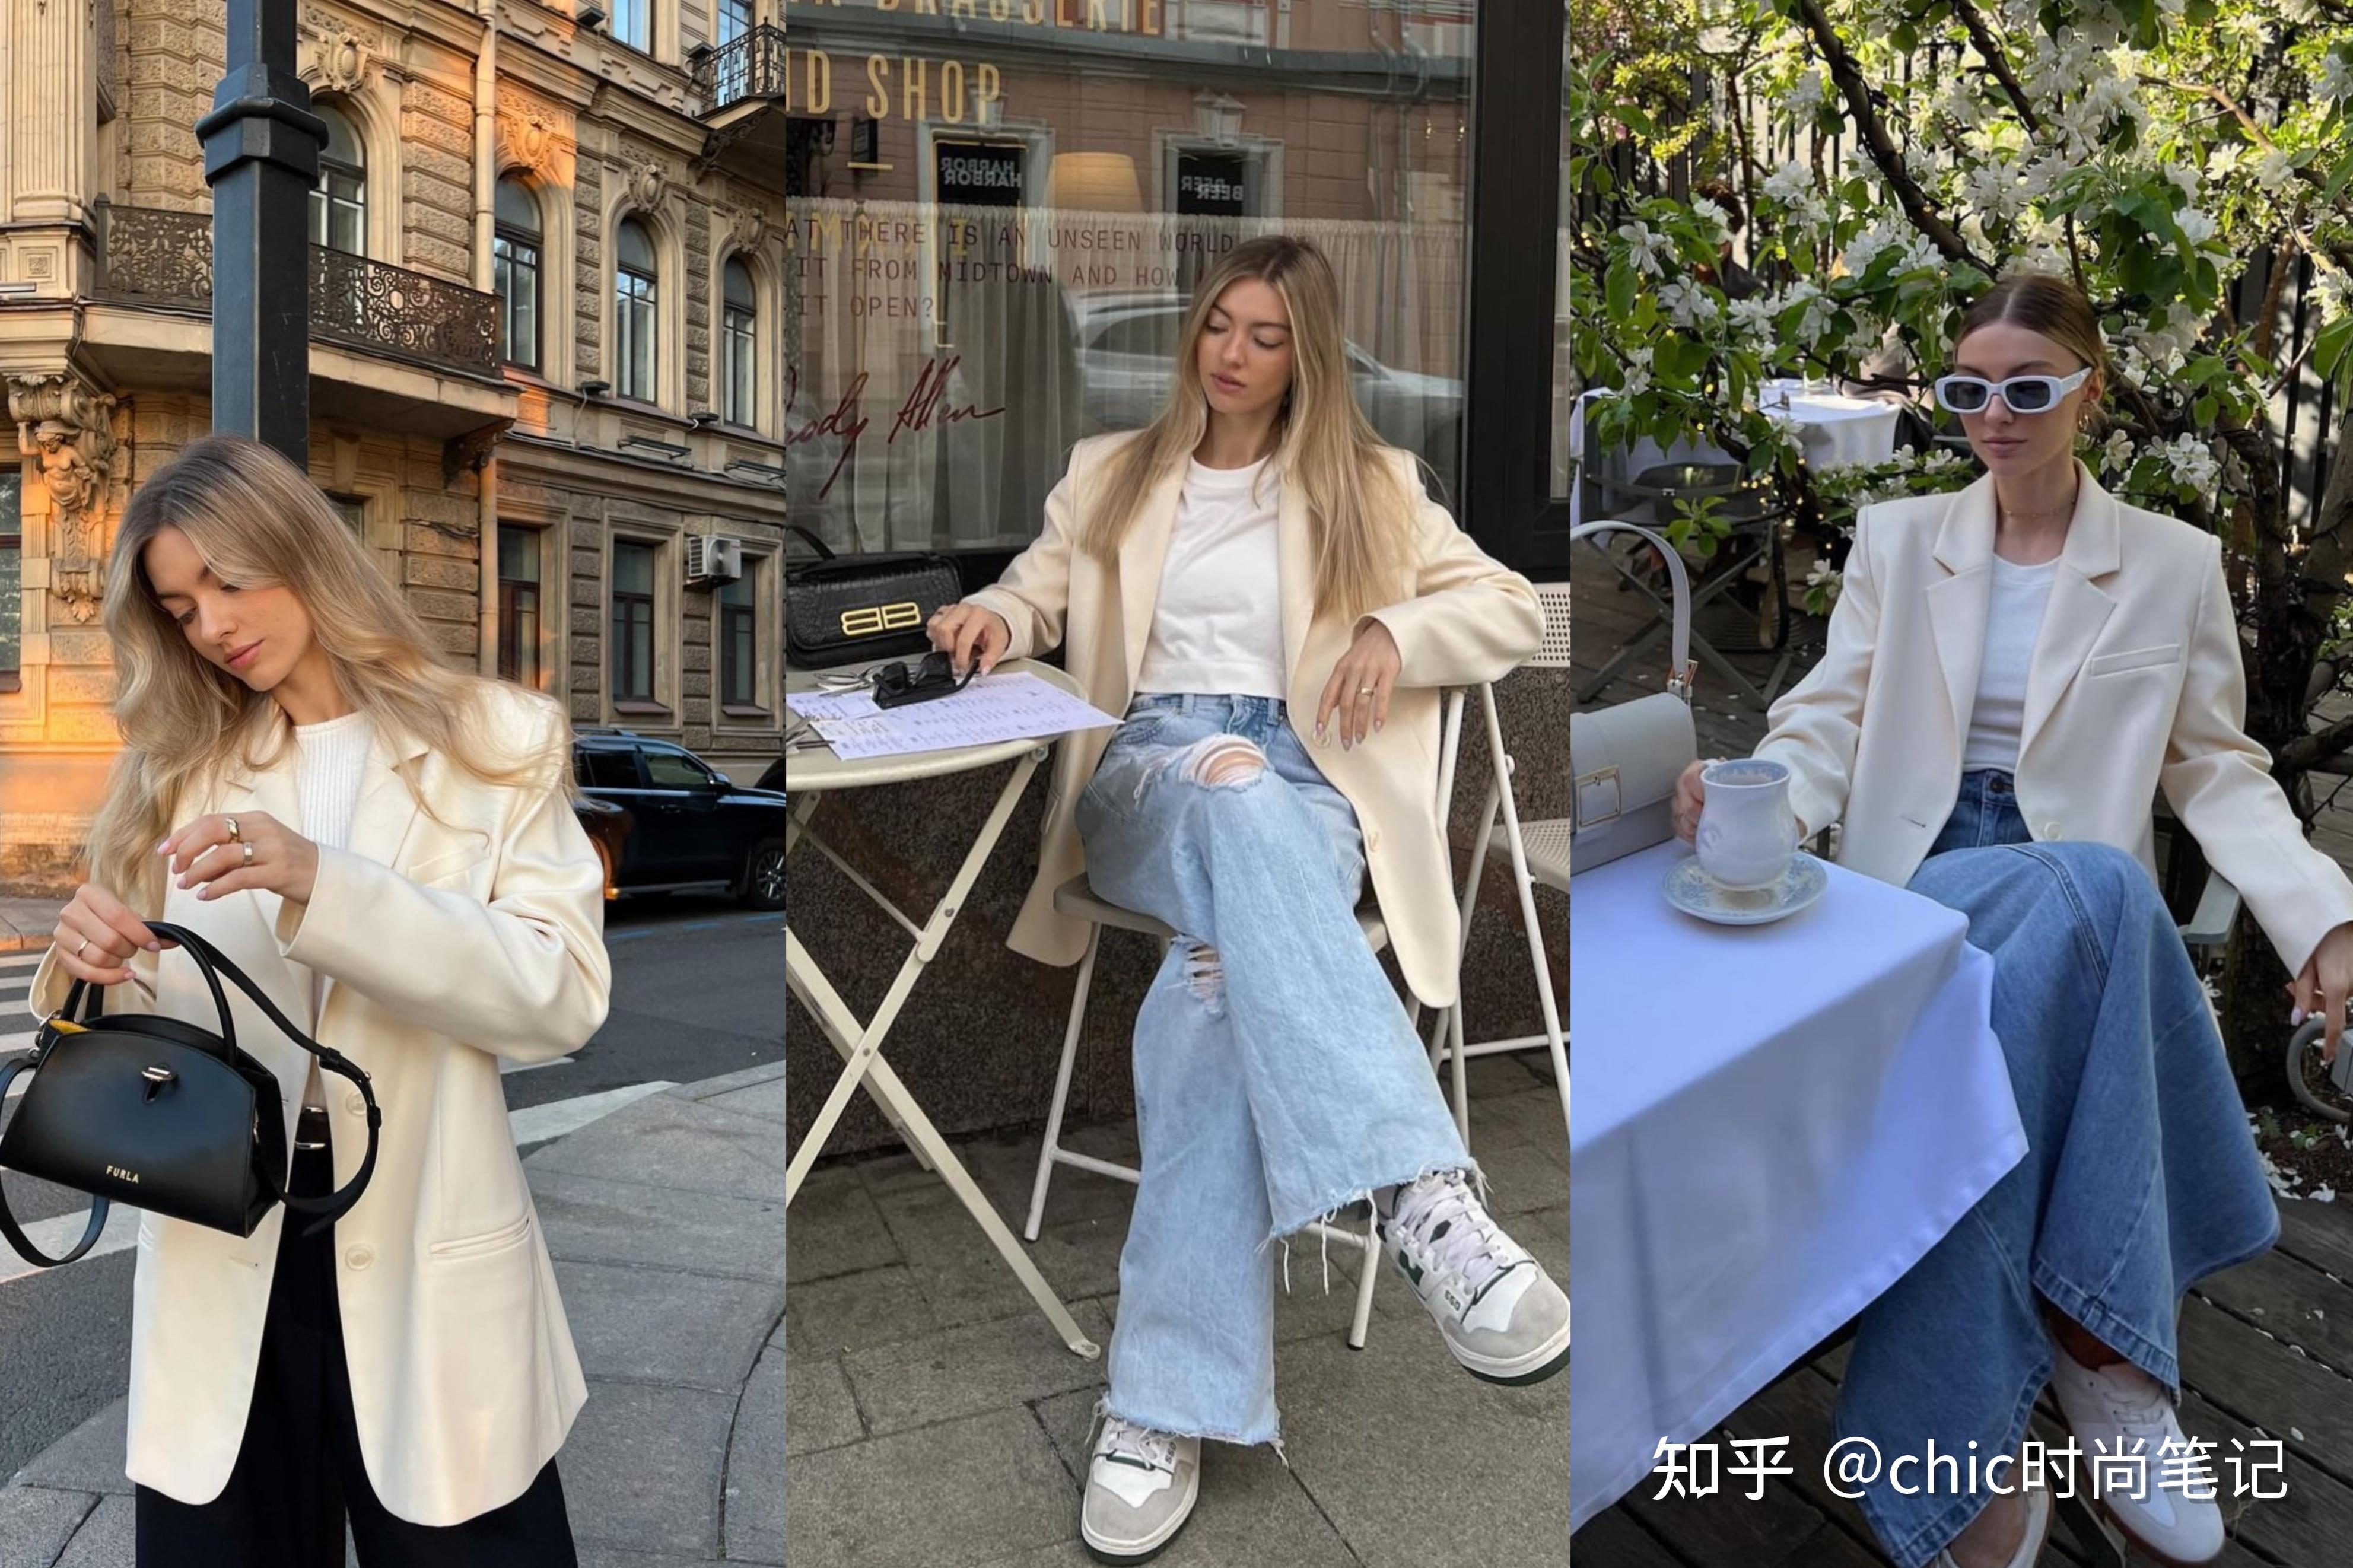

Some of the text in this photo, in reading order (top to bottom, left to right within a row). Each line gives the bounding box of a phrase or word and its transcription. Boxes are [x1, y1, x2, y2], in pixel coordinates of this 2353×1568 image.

[867, 54, 1000, 125] SHOP
[841, 220, 925, 243] THERE
[949, 224, 978, 245] IS
[998, 226, 1025, 246] AN
[1048, 229, 1141, 250] UNSEEN
[1159, 232, 1233, 253] WORLD
[797, 257, 828, 277] IT
[851, 259, 917, 280] FROM
[939, 261, 1052, 284] MIDTOWN
[1072, 265, 1117, 285] AND
[1136, 267, 1179, 286] HOW
[797, 295, 933, 318] IT OPEN?
[106, 1165, 139, 1184] FURLA
